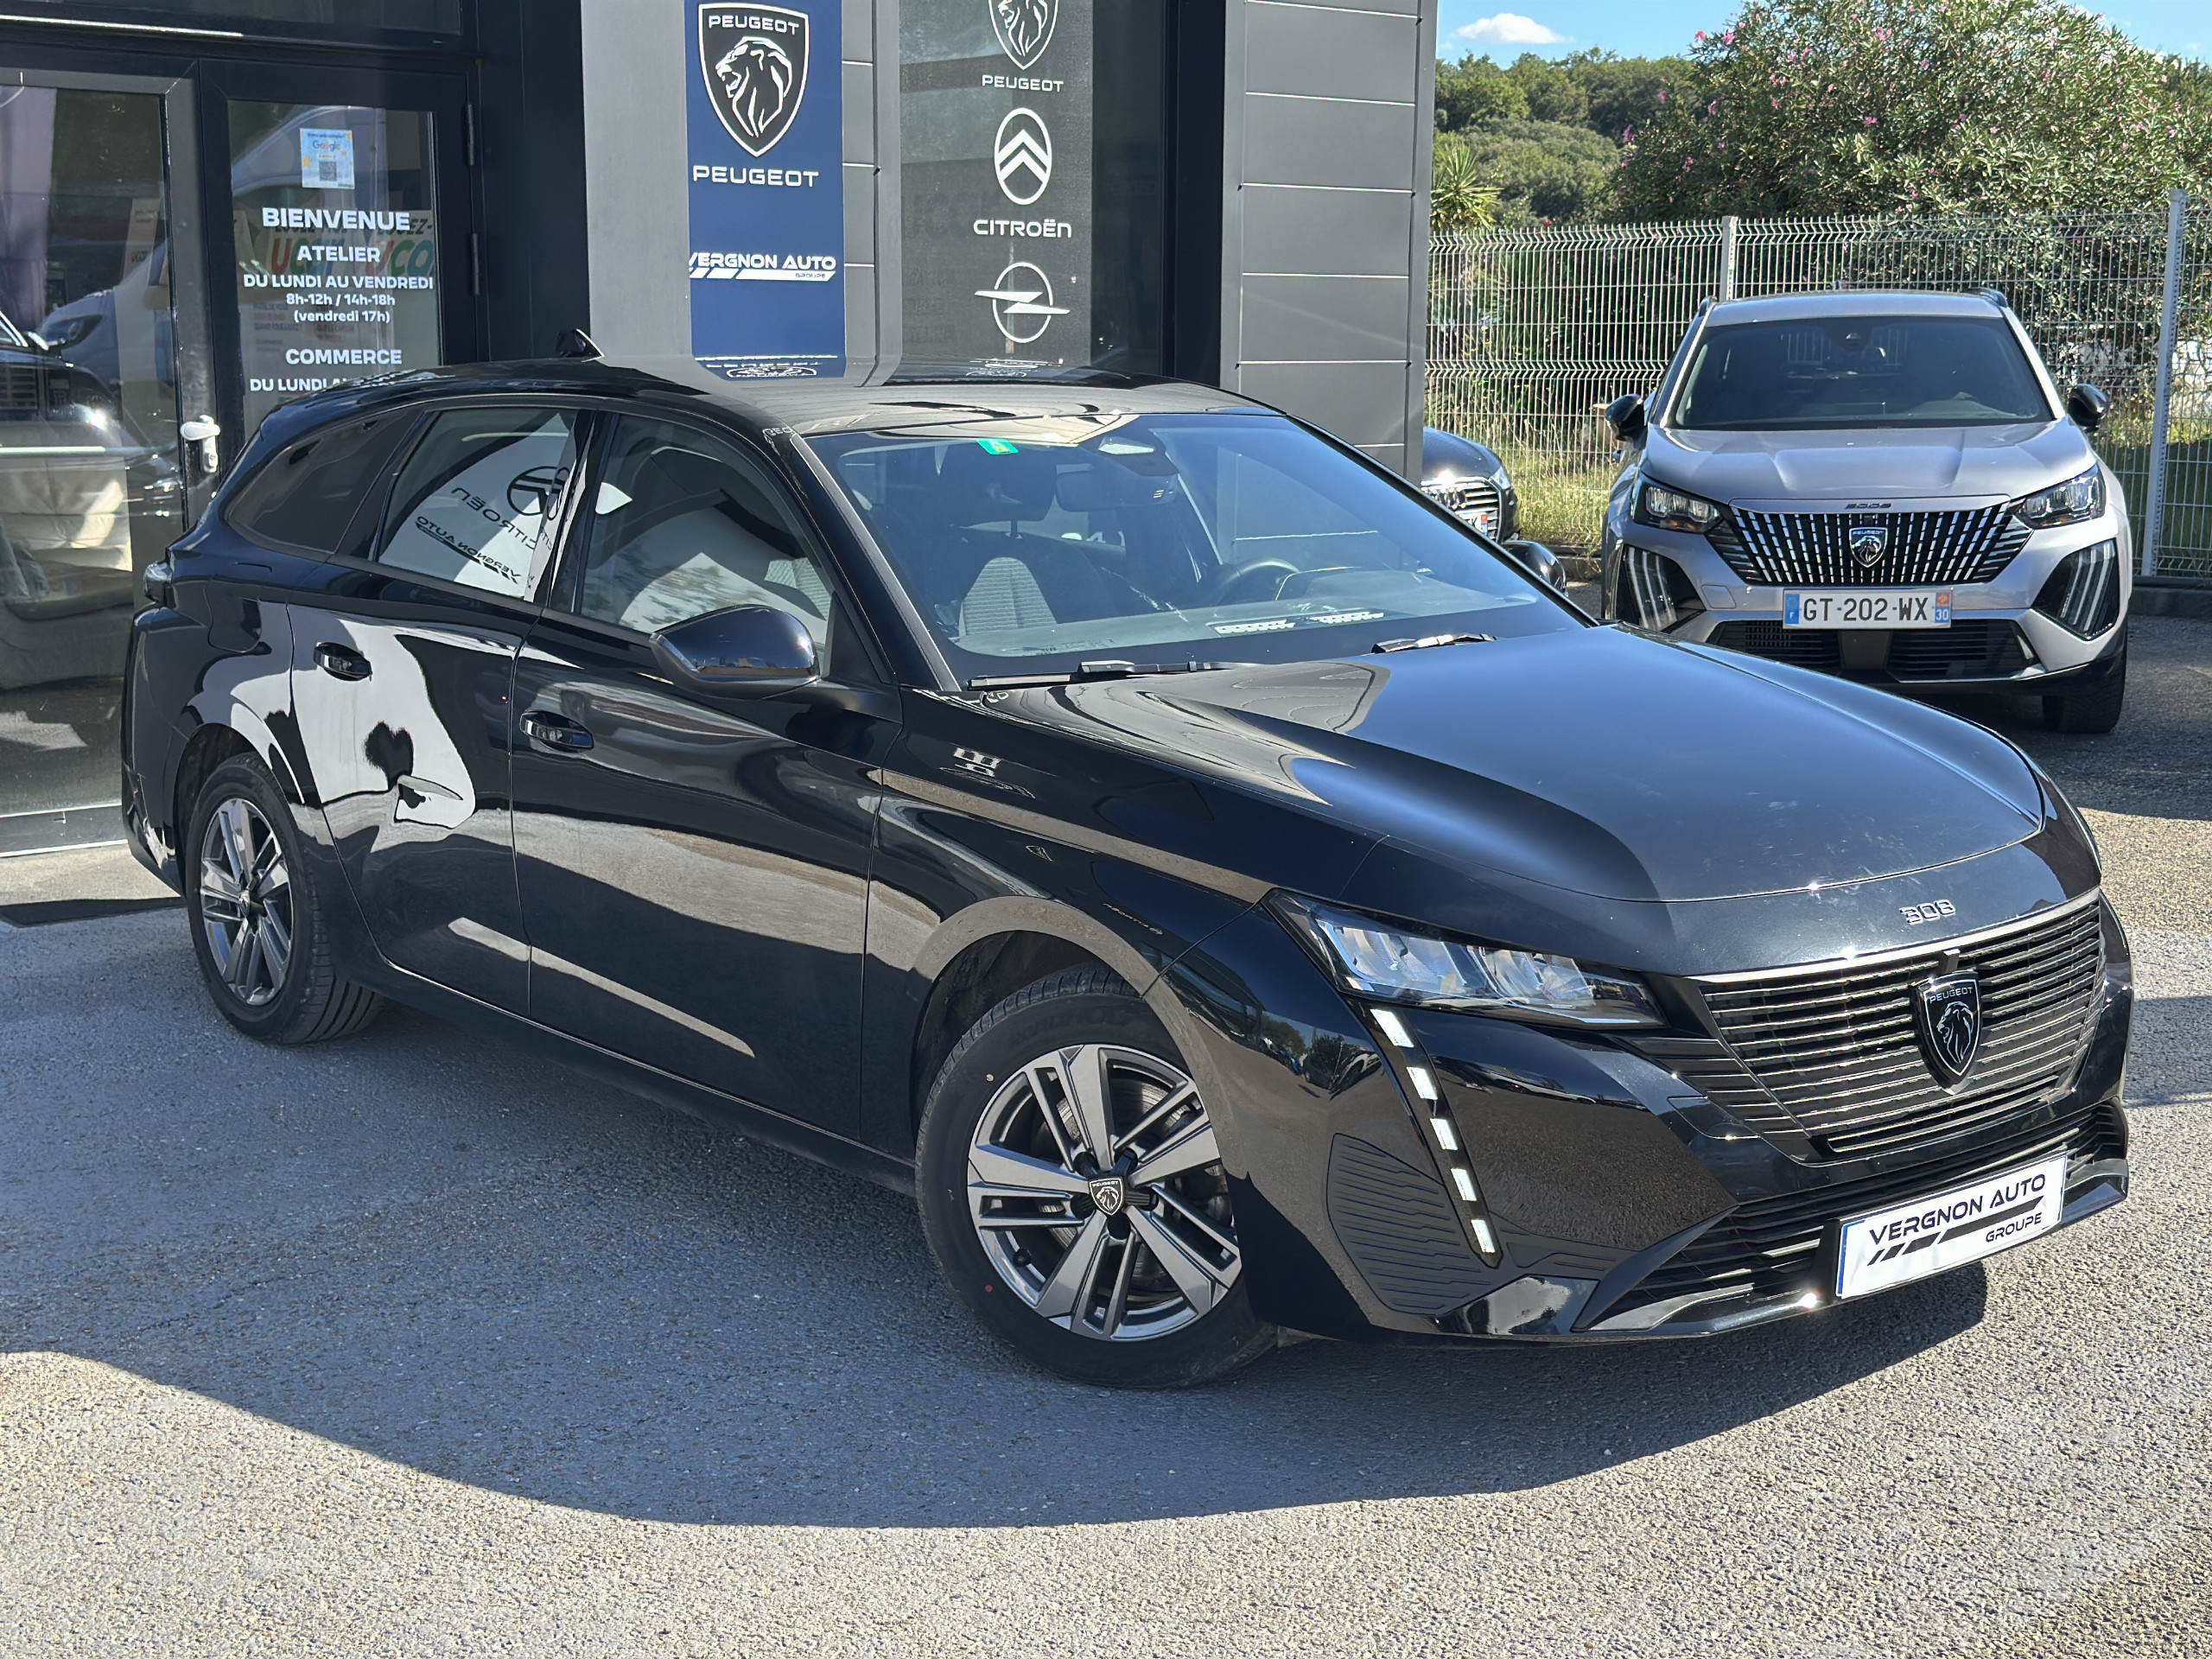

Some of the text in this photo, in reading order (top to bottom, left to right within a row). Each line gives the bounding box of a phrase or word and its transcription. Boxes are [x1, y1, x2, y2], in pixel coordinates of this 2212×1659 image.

[709, 15, 799, 35] PEUGEOT
[982, 74, 1064, 92] PEUGEOT
[693, 165, 819, 188] PEUGEOT
[262, 207, 410, 231] BIENVENUE
[973, 219, 1073, 238] CITROËN
[296, 245, 380, 263] ATELIER
[782, 255, 836, 270] AUTO
[244, 274, 434, 289] DU LUNDI AU VENDREDI
[286, 293, 396, 307] 8h-12h / 14h-18h
[294, 310, 359, 323] (vendredi
[362, 310, 391, 323] 17h)
[286, 349, 403, 365] COMMERCE
[250, 378, 274, 391] DU
[277, 378, 327, 391] LUNDI
[1803, 598, 1929, 622] GT-202-WX
[1936, 609, 1949, 621] 30
[1899, 899, 1956, 925] 308
[1929, 987, 1974, 1003] PEUGEOT
[1869, 1173, 2046, 1245] VERGNON AUTO
[1986, 1211, 2043, 1243] GROUPE
